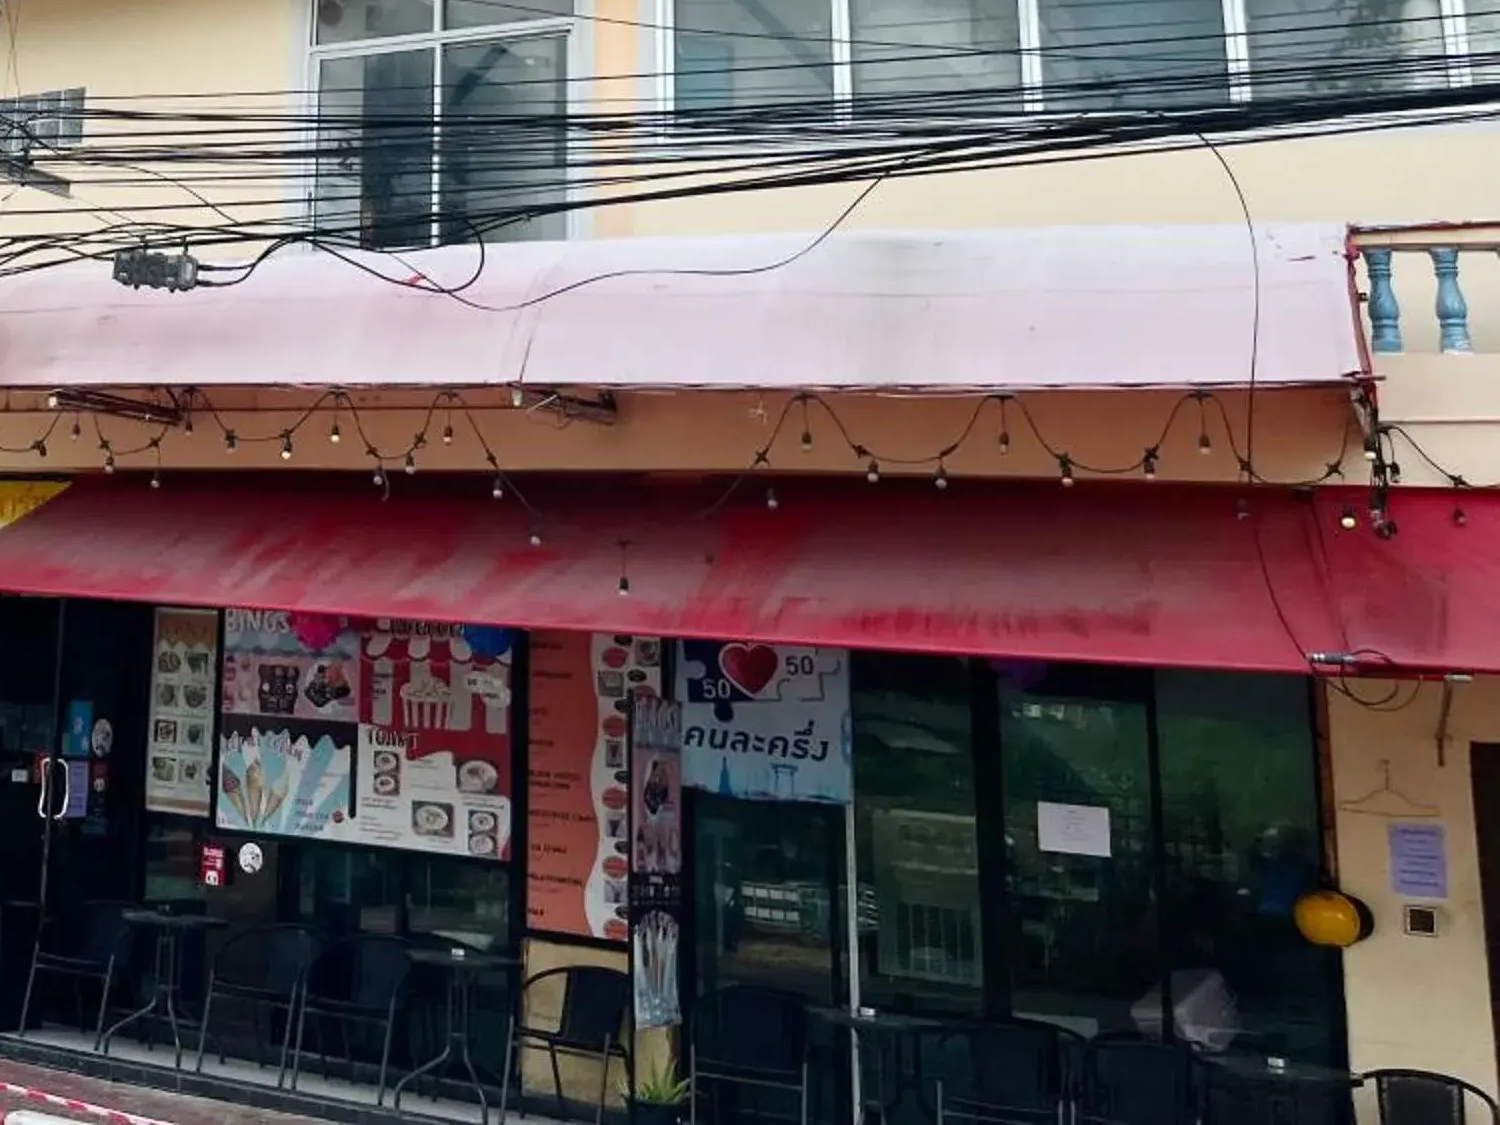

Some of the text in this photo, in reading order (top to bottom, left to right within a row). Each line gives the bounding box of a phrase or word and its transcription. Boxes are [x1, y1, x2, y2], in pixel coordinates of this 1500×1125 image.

[225, 607, 292, 634] BINGS
[785, 655, 814, 676] 50
[702, 678, 731, 699] 50
[683, 719, 830, 762] คนละครึ่ง
